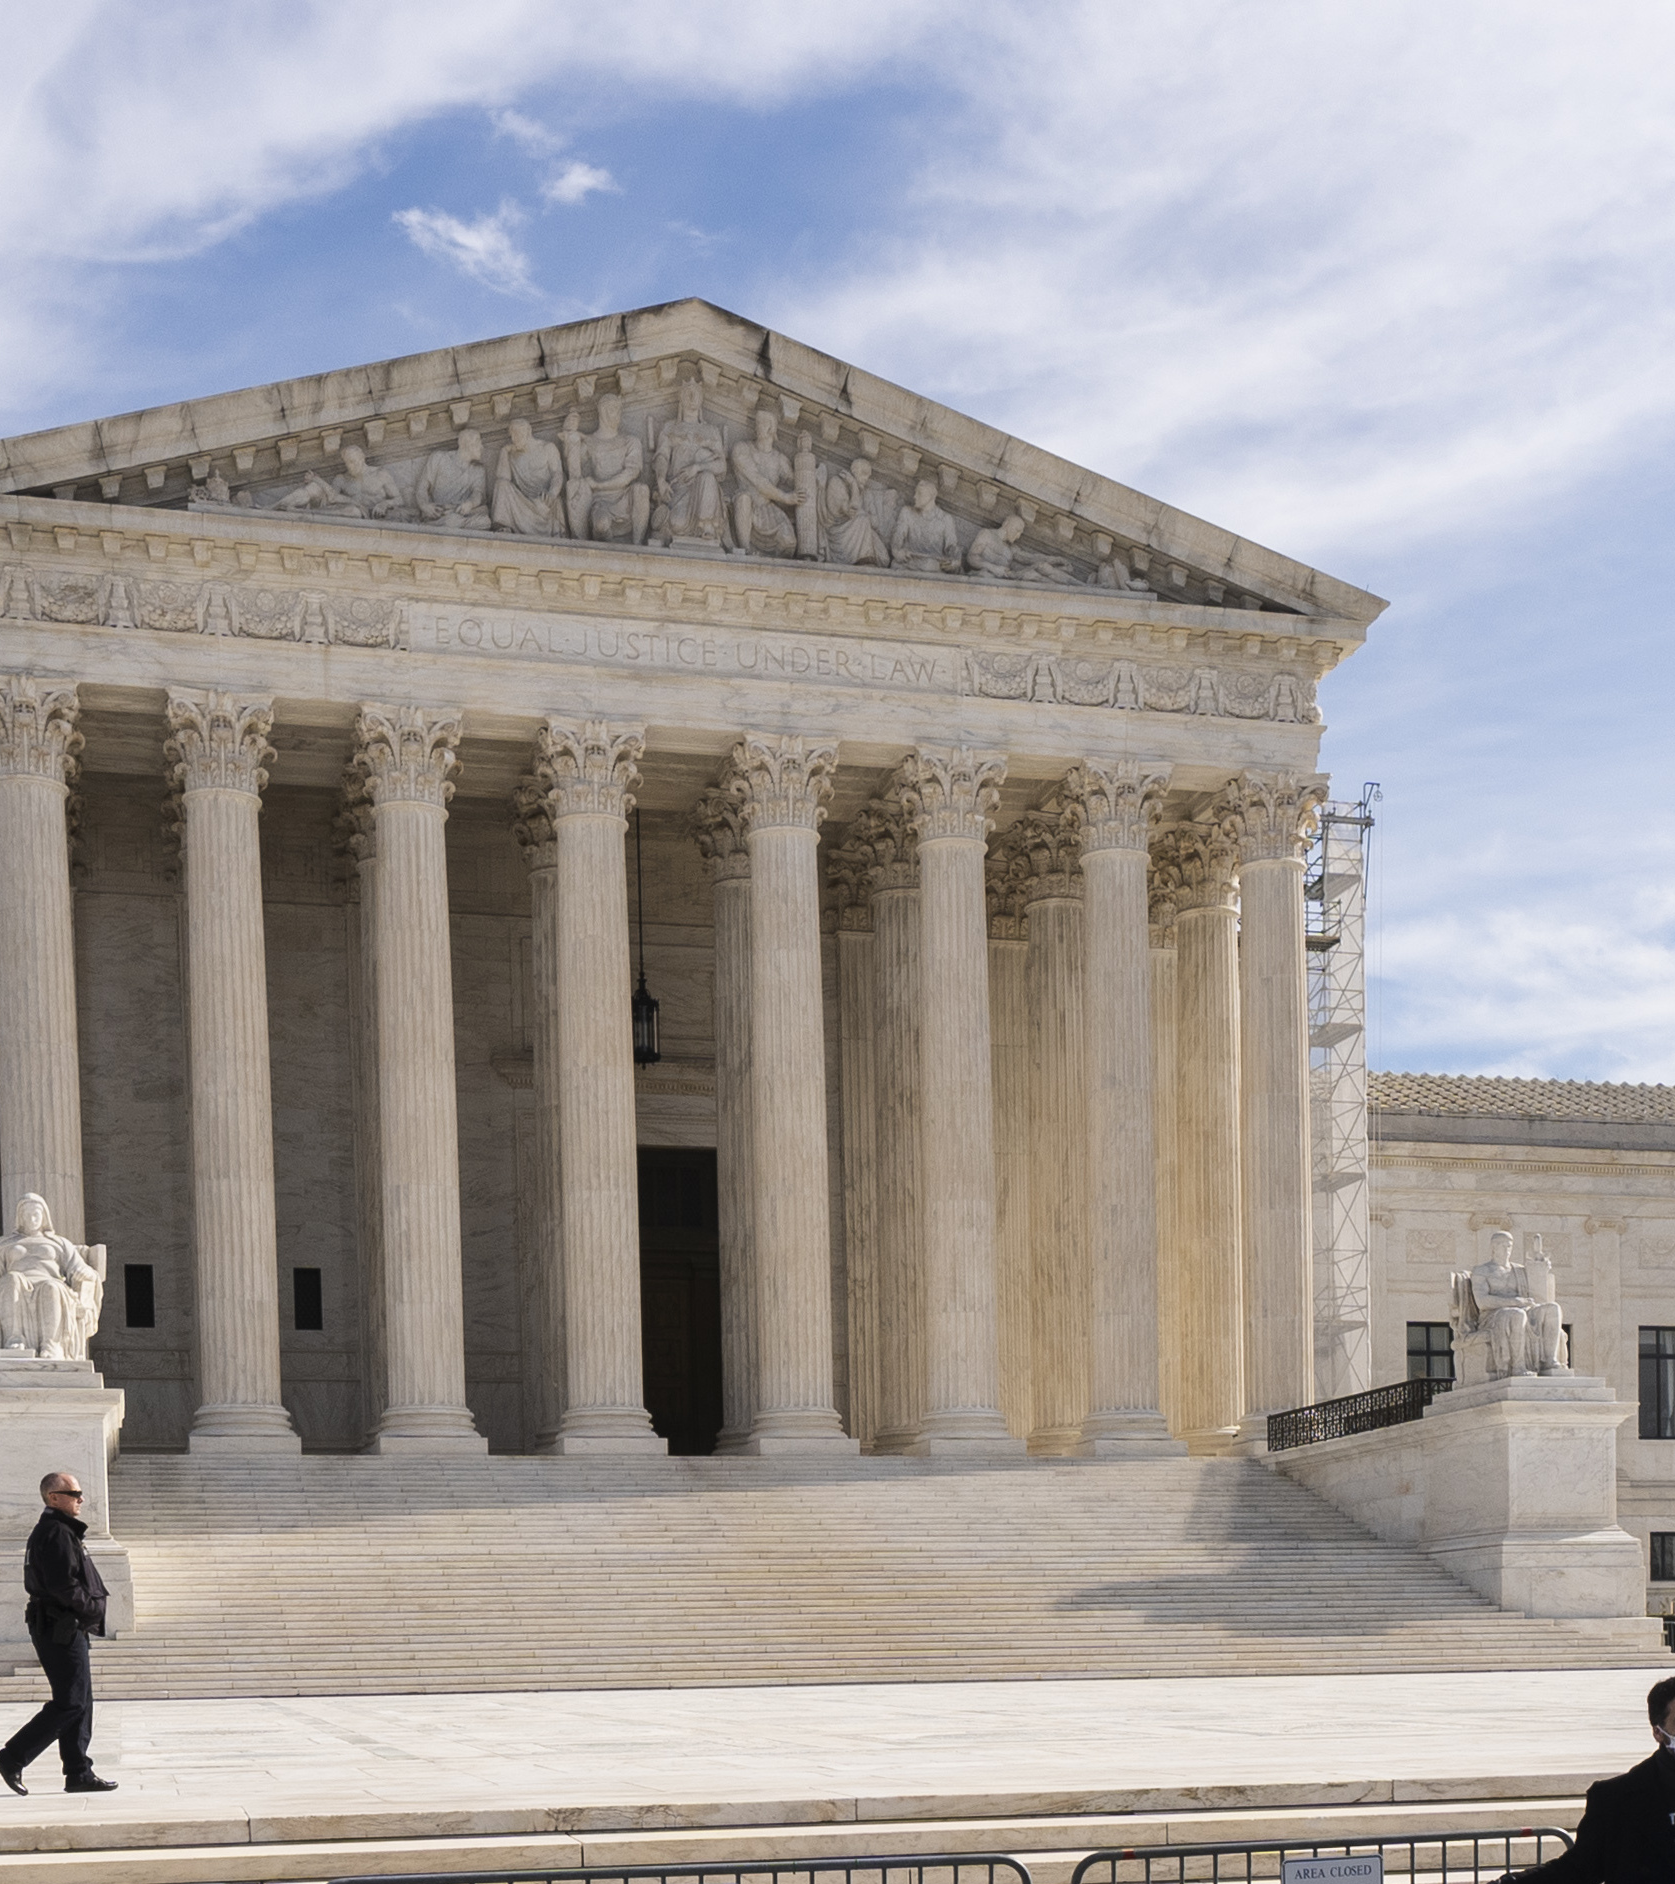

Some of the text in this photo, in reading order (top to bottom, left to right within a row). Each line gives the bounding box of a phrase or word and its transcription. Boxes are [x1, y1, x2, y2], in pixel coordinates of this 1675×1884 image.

[434, 616, 937, 684] EQUAL JUSTICE UNDER LAW
[1295, 1865, 1372, 1880] AREA CLOSED
